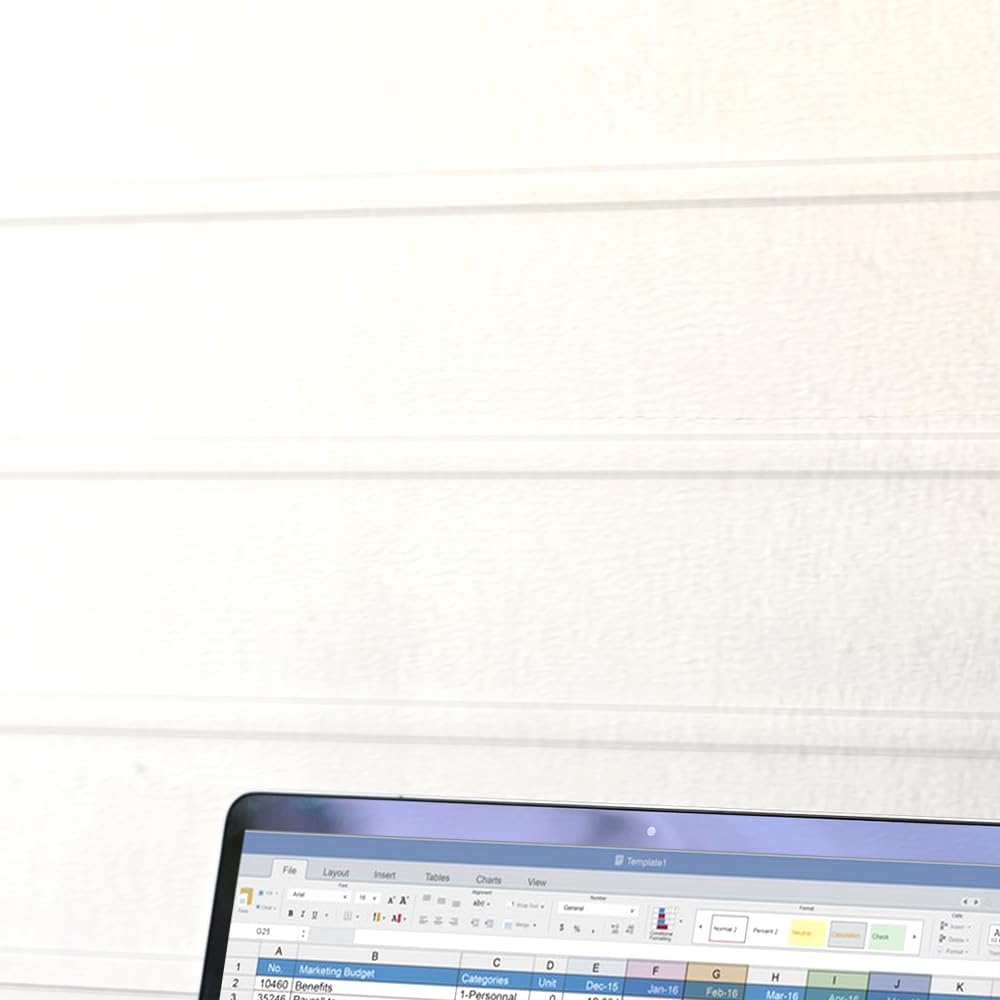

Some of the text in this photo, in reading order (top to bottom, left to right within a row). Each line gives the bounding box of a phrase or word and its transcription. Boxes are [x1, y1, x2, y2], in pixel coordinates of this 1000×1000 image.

[627, 858, 666, 867] Template1
[283, 867, 297, 875] File
[323, 868, 349, 878] Layout
[374, 871, 396, 879] Insert
[425, 873, 450, 882] Tables
[476, 875, 502, 885] Charts
[528, 878, 547, 887] View
[300, 966, 375, 979] Marketing Budget
[462, 973, 508, 985] Categories
[539, 978, 557, 988] Unit
[260, 980, 288, 989] 10460
[295, 981, 332, 992] Benefits
[586, 981, 618, 991] Dec-15
[648, 984, 679, 995] Jan-16
[706, 987, 738, 997] Feb-16
[766, 990, 799, 1000] Mar-16
